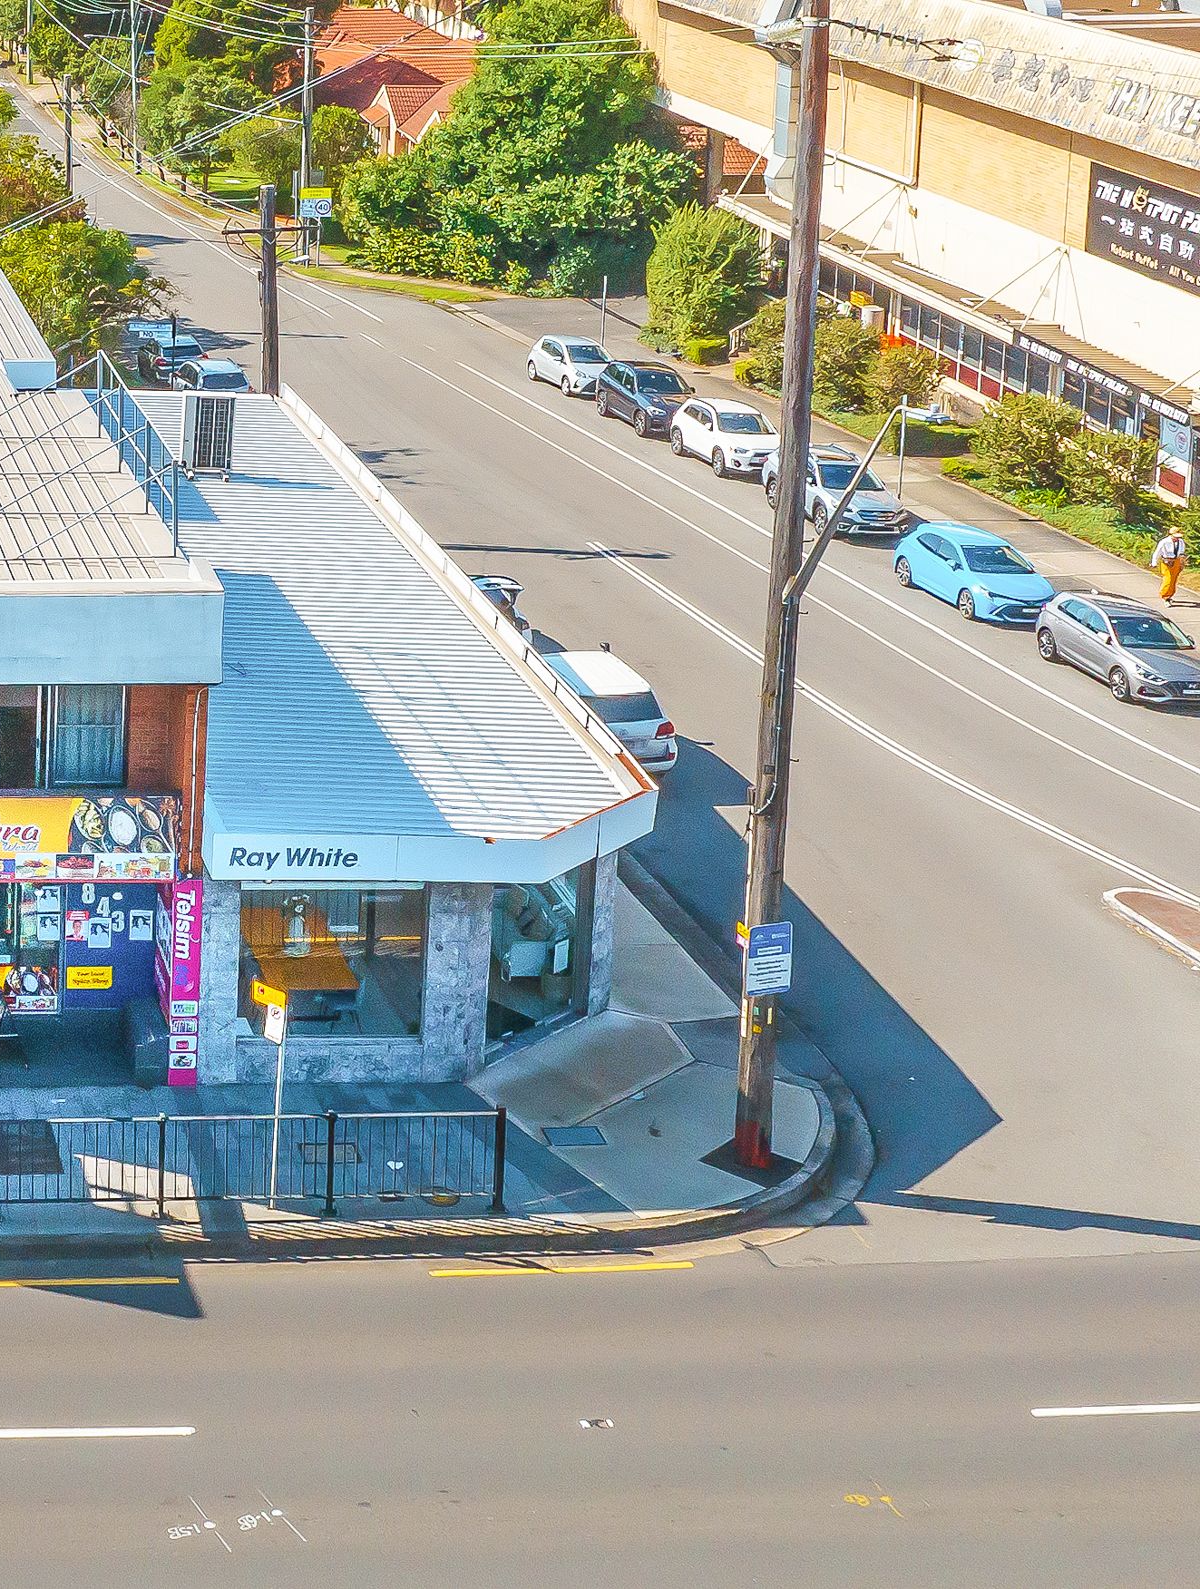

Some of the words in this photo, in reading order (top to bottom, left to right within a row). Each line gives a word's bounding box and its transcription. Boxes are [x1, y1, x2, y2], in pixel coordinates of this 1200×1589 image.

[1095, 180, 1121, 204] THE
[318, 203, 329, 211] 40
[229, 847, 280, 871] Ray
[286, 847, 359, 867] White
[175, 890, 198, 960] Telsim
